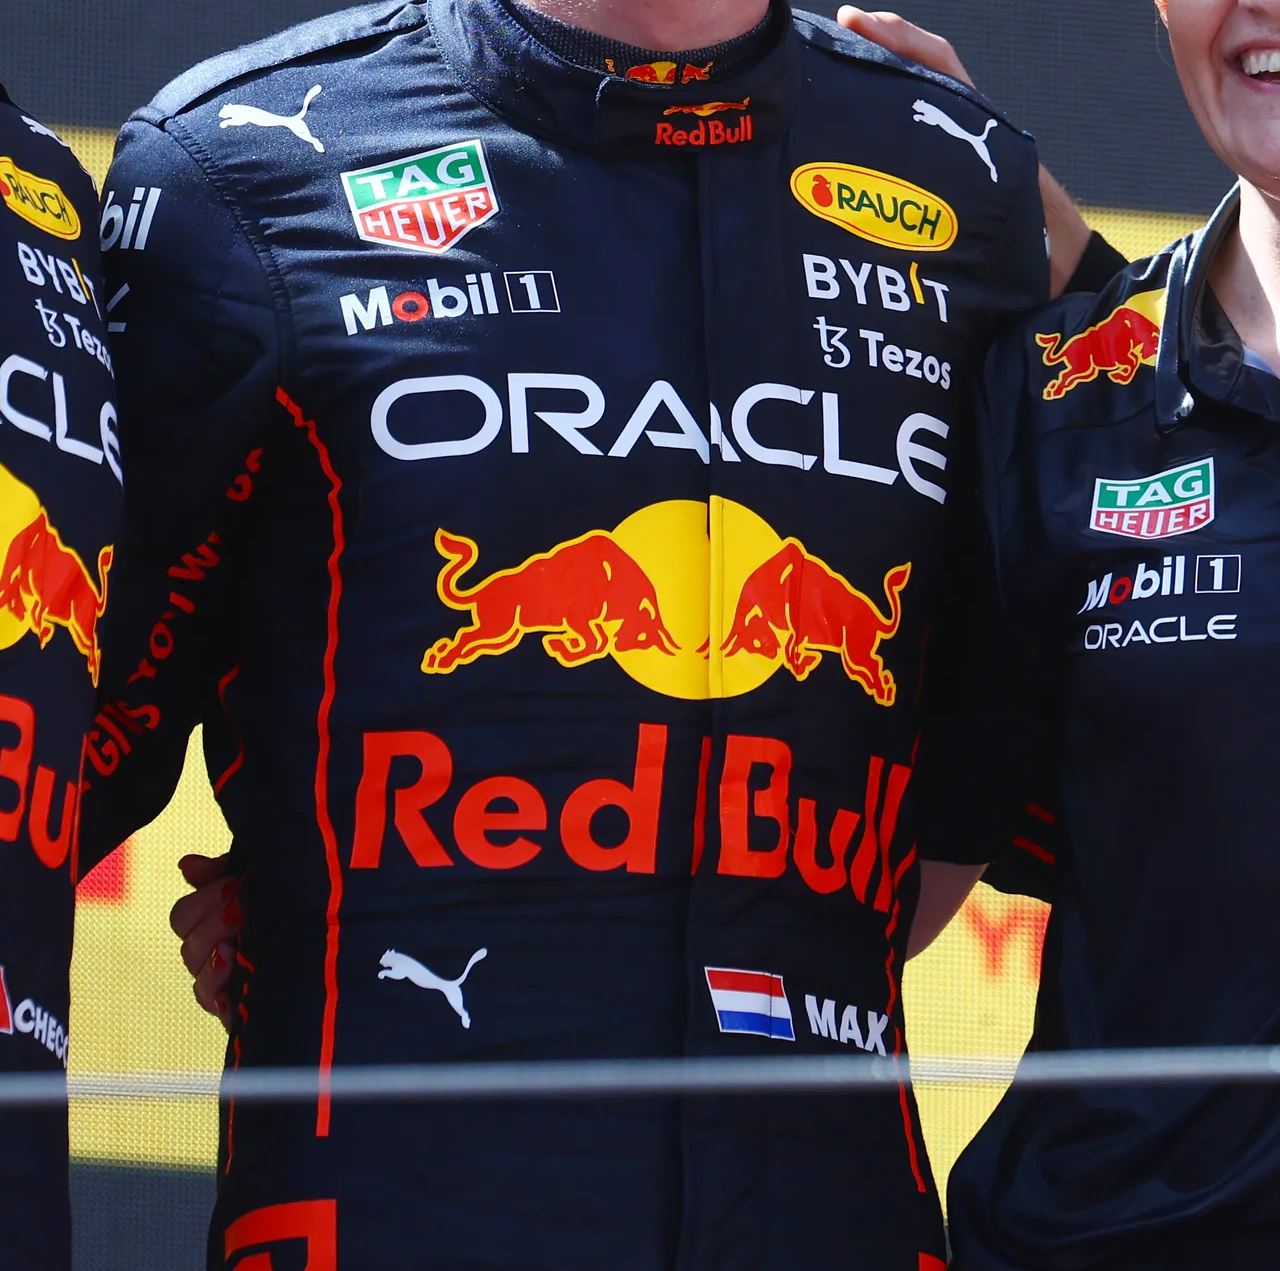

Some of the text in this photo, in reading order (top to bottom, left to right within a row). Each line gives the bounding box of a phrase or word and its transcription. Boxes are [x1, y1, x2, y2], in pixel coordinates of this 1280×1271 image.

[655, 115, 752, 146] Red Bull
[4, 173, 73, 227] RAUCH
[355, 151, 476, 201] TAG
[100, 186, 162, 252] bil
[363, 191, 487, 246] HEUER
[837, 182, 942, 240] RAUCH
[339, 272, 499, 336] Mobil
[802, 253, 950, 323] BYBIT
[859, 328, 952, 390] Tezos
[370, 372, 951, 505] ORACLE
[1106, 469, 1204, 507] TAG
[1098, 502, 1207, 537] HEUER
[1076, 555, 1186, 616] Mobil
[1084, 614, 1238, 650] ORACLE
[350, 723, 912, 914] Red Bull
[804, 993, 889, 1057] MAX
